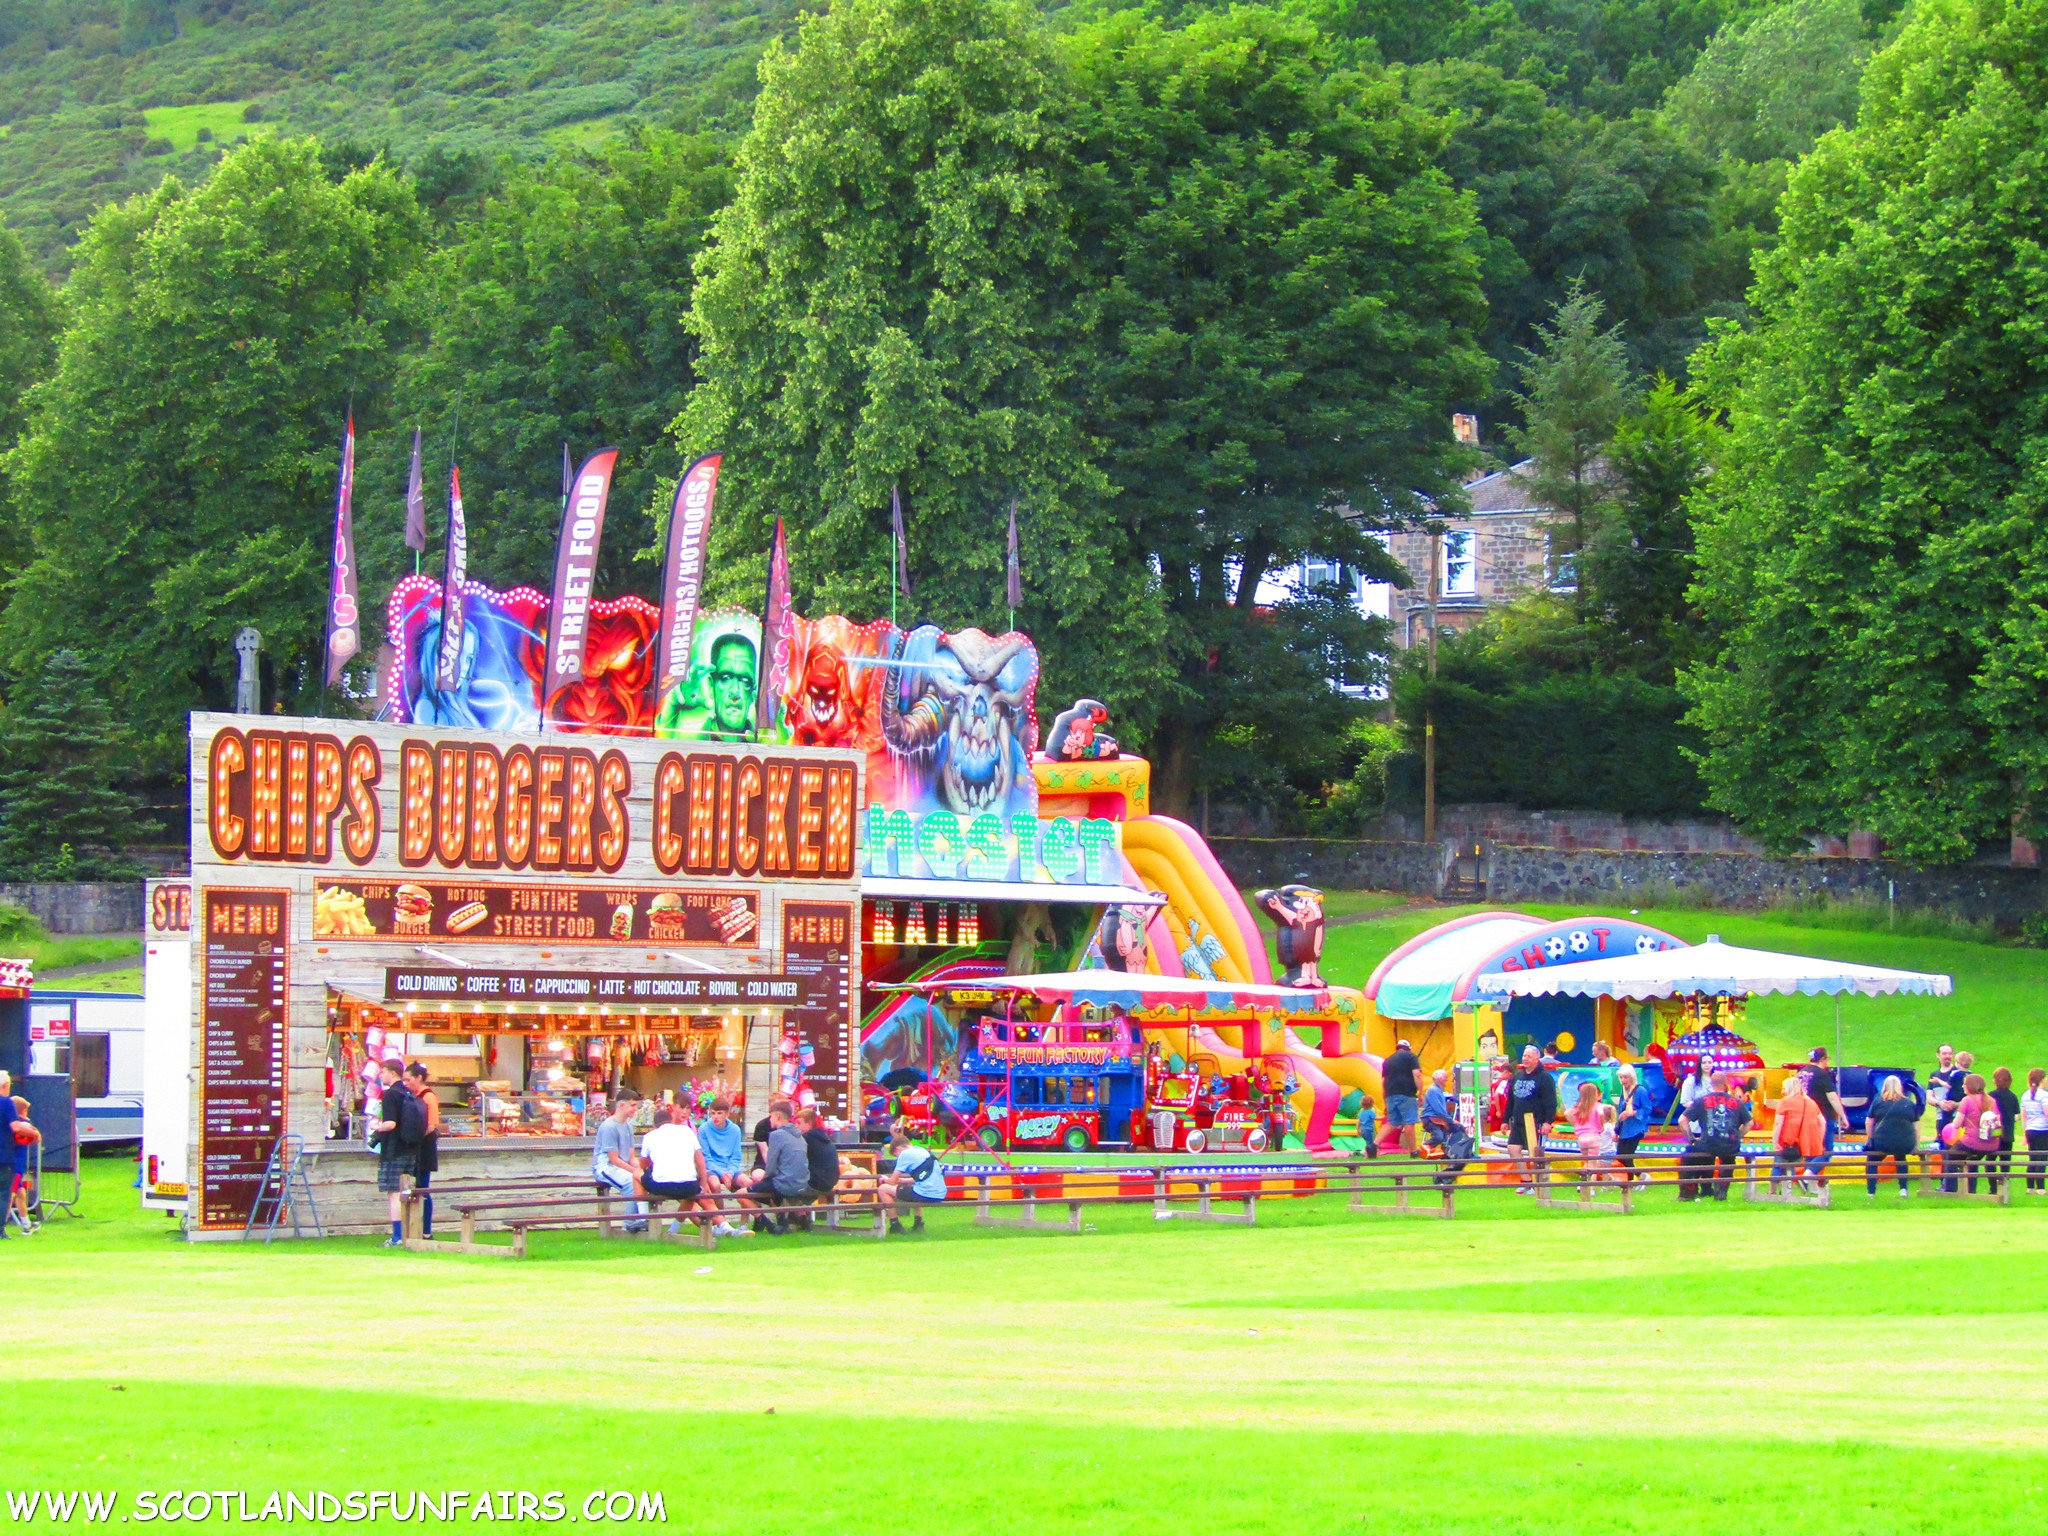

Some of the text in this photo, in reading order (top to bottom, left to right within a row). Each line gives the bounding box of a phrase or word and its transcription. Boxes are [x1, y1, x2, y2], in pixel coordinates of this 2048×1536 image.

[556, 476, 604, 674] STREET FOOD
[669, 480, 710, 677] BURGERS/HOTDOGS
[214, 734, 851, 873] CHIPS BURGERS CHICKEN
[362, 886, 391, 900] CHIPS
[447, 888, 486, 902] HOT DOG
[510, 890, 578, 913] FUNTIME
[606, 893, 638, 906] WRAPS
[687, 894, 732, 909] FOOT LONG
[212, 903, 279, 935] MENU
[393, 922, 431, 934] BURGER
[494, 916, 595, 938] STREET FOOD
[789, 915, 845, 944] MENU
[648, 926, 686, 940] CHICKEN
[398, 975, 798, 996] COLD DRINKS COFFEE TEA CAPPUCCINO LATTE HOT CHOCOLATE BOVRIL COLD WATER
[1017, 1047, 1043, 1065] FUN
[1046, 1047, 1107, 1065] FACTORY
[1016, 1115, 1061, 1138] HAPPY
[1224, 1113, 1244, 1121] FIRE
